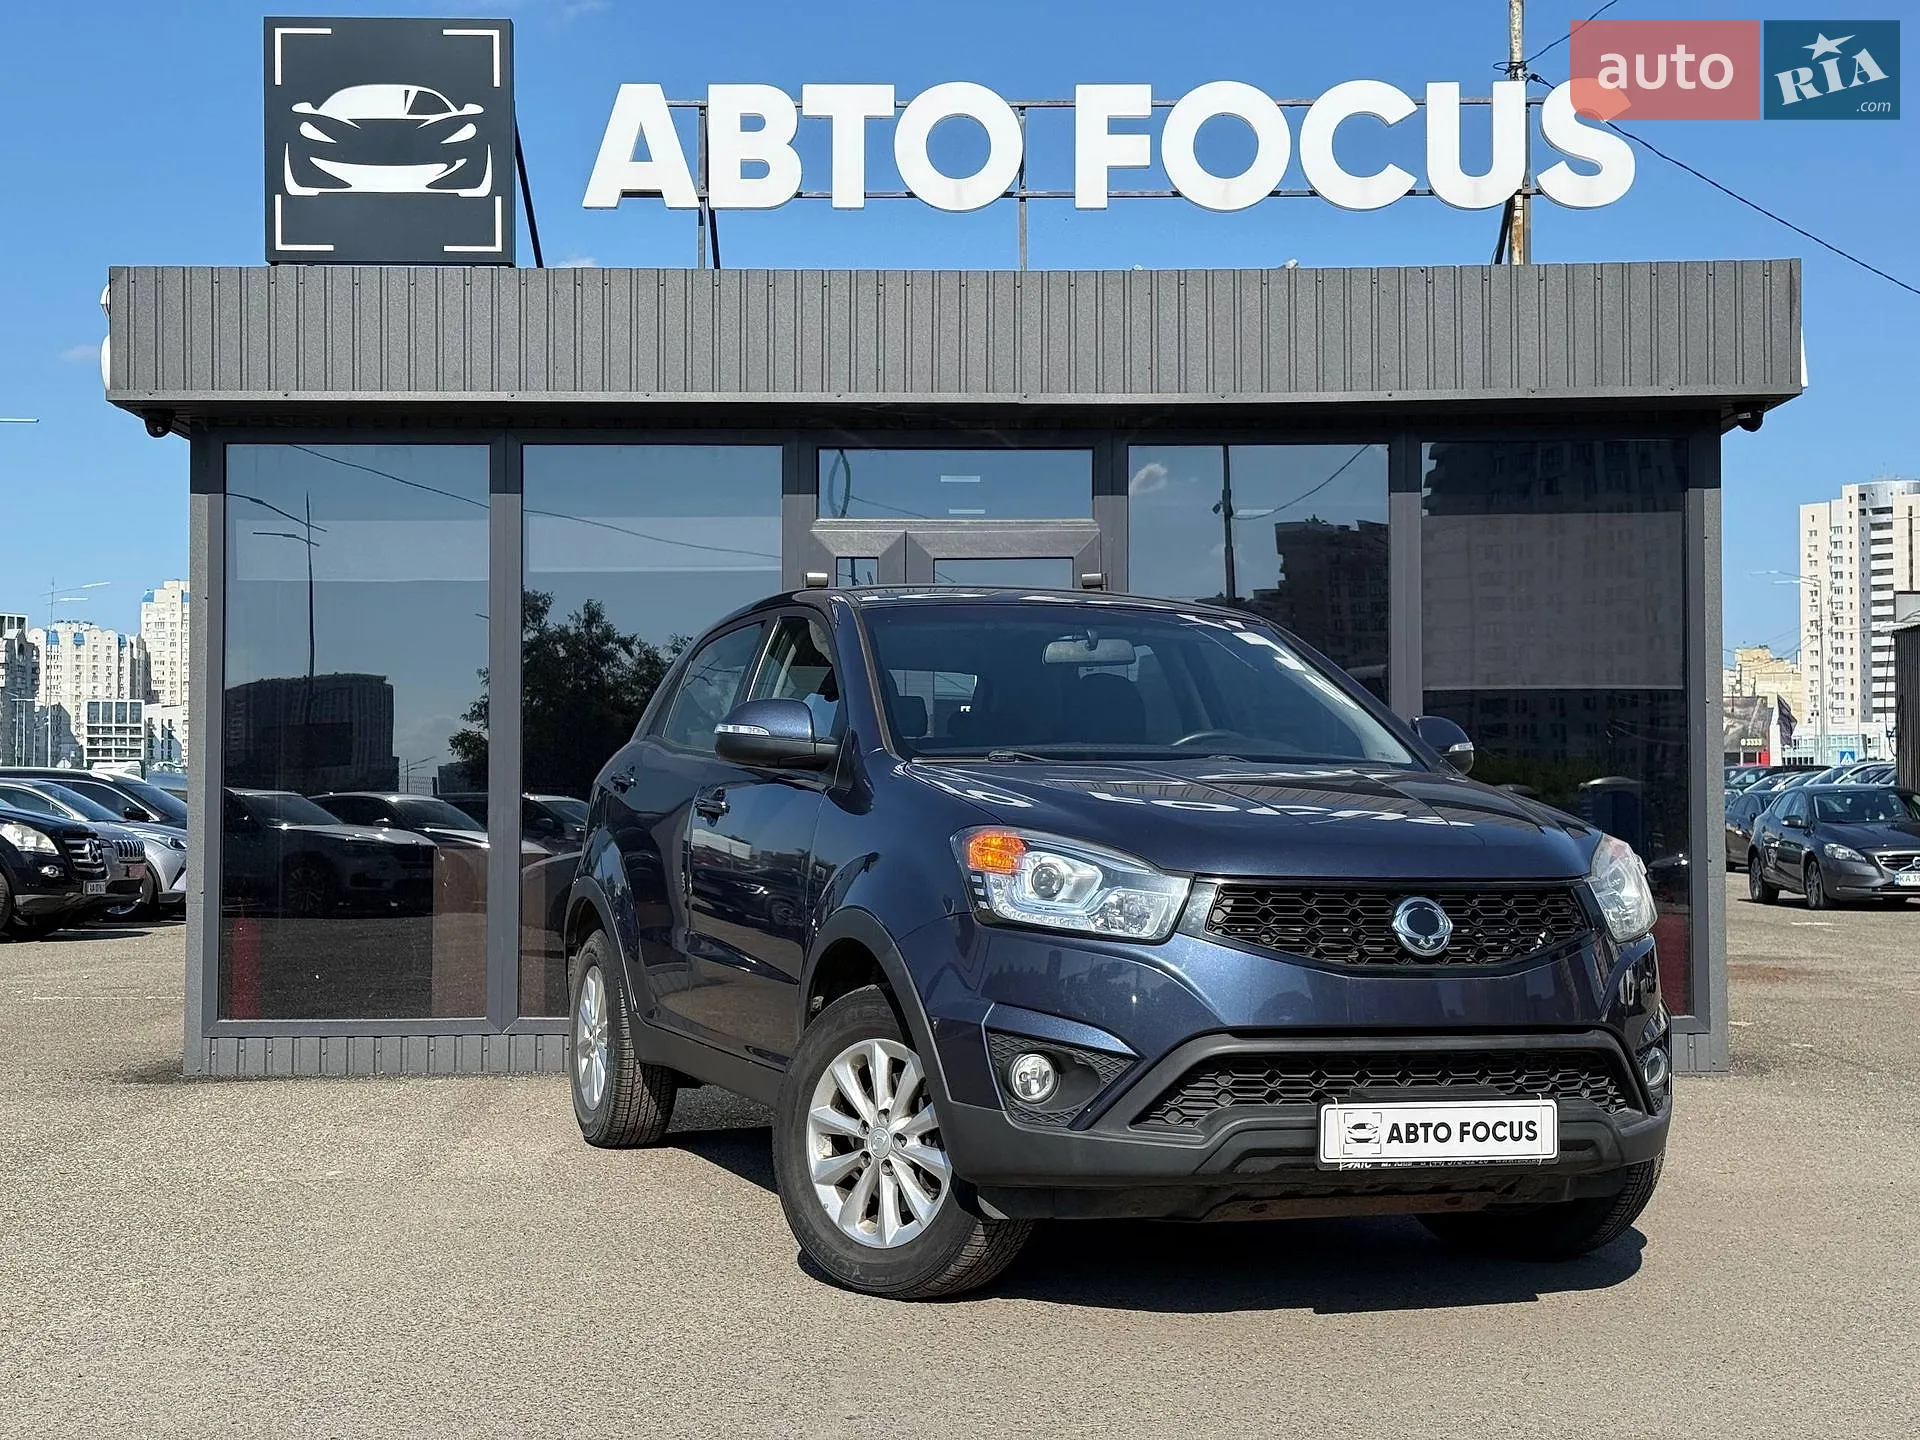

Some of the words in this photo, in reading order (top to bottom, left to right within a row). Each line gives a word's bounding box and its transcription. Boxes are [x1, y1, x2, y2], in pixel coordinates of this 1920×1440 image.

[583, 81, 1024, 212] АВТО
[1075, 79, 1637, 211] FOCUS
[1386, 1121, 1452, 1144] АВТО
[1459, 1120, 1539, 1143] FOCUS
